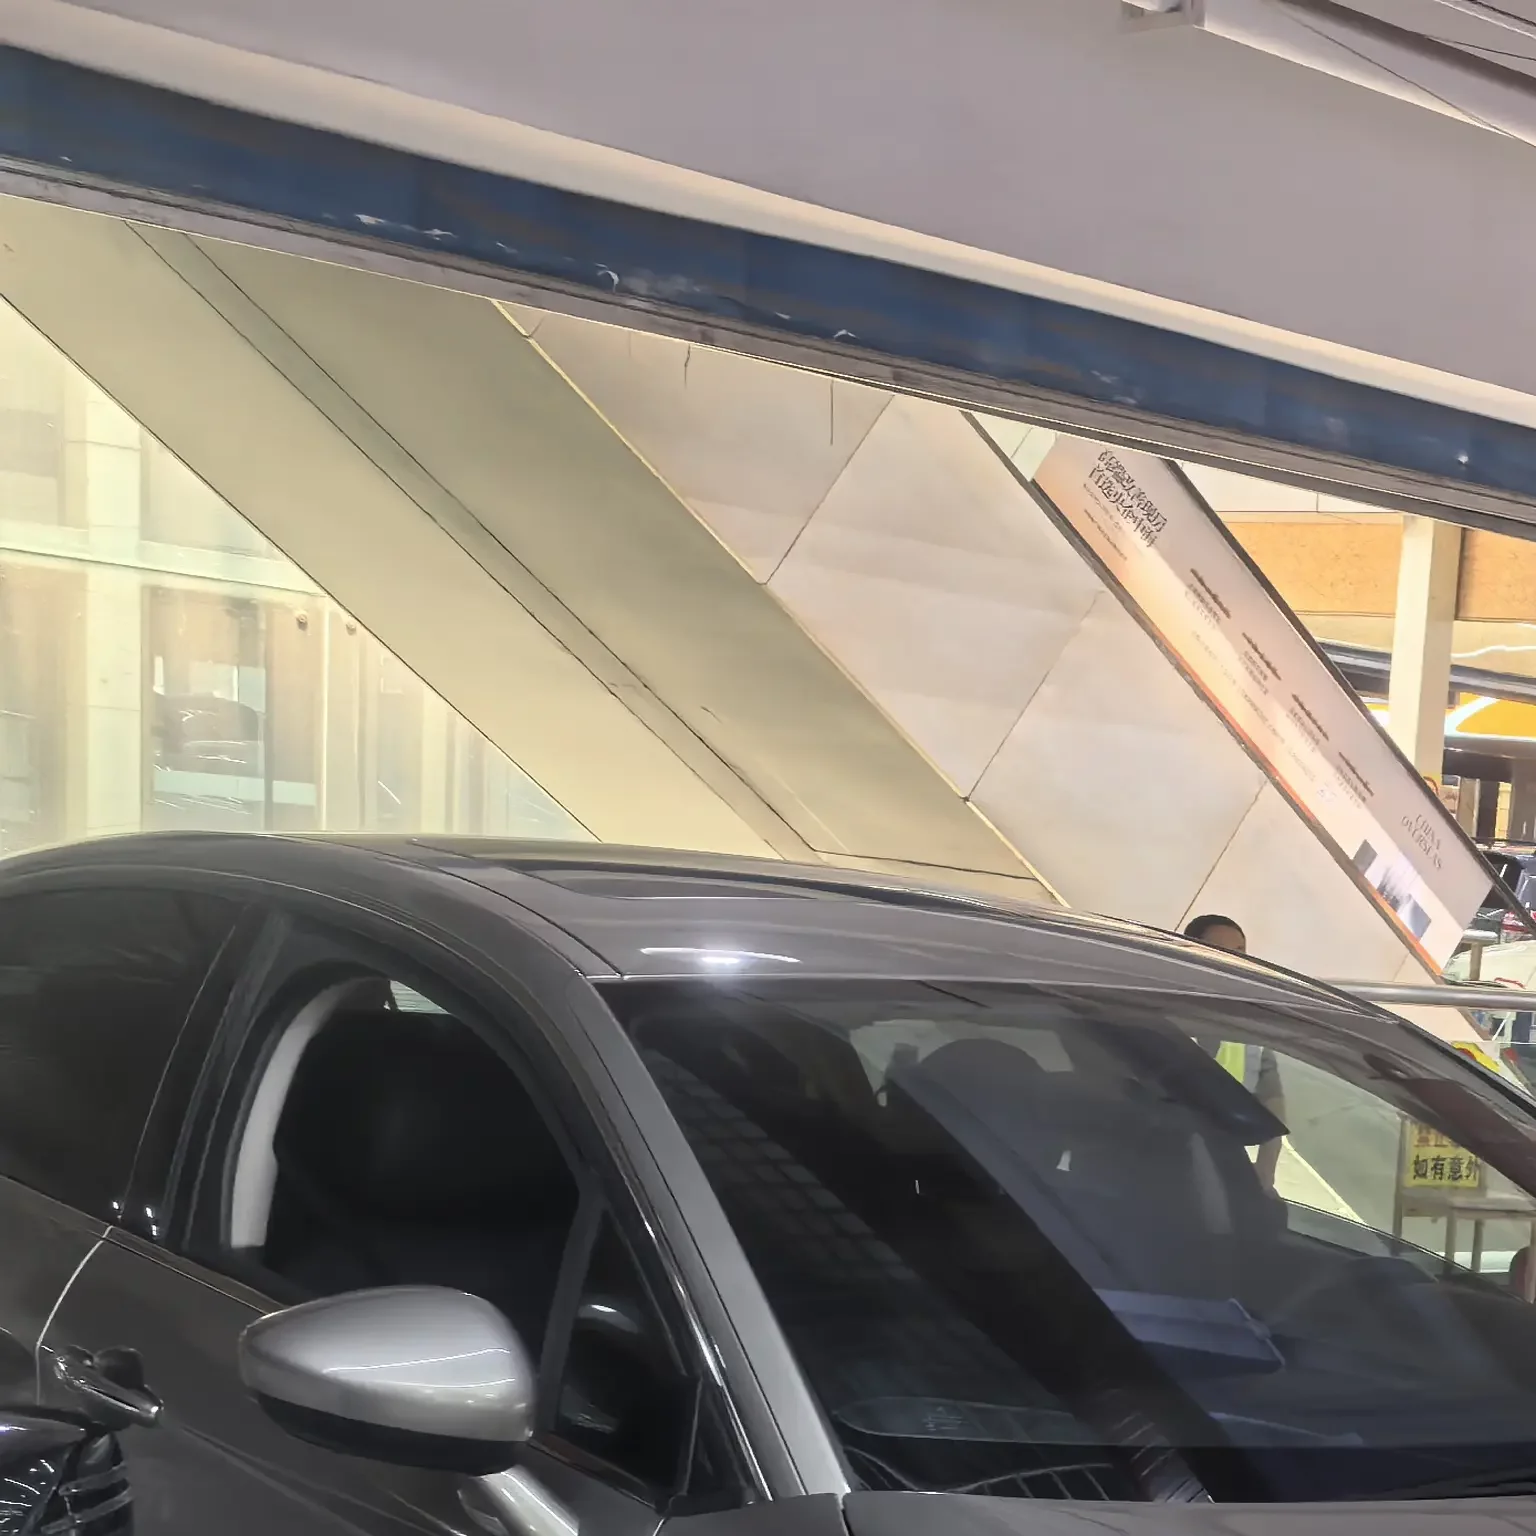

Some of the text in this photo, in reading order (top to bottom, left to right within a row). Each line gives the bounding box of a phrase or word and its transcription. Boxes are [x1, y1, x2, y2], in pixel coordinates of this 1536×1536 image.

[1414, 1123, 1462, 1148] 禁止
[1413, 1154, 1480, 1181] 如有意外
